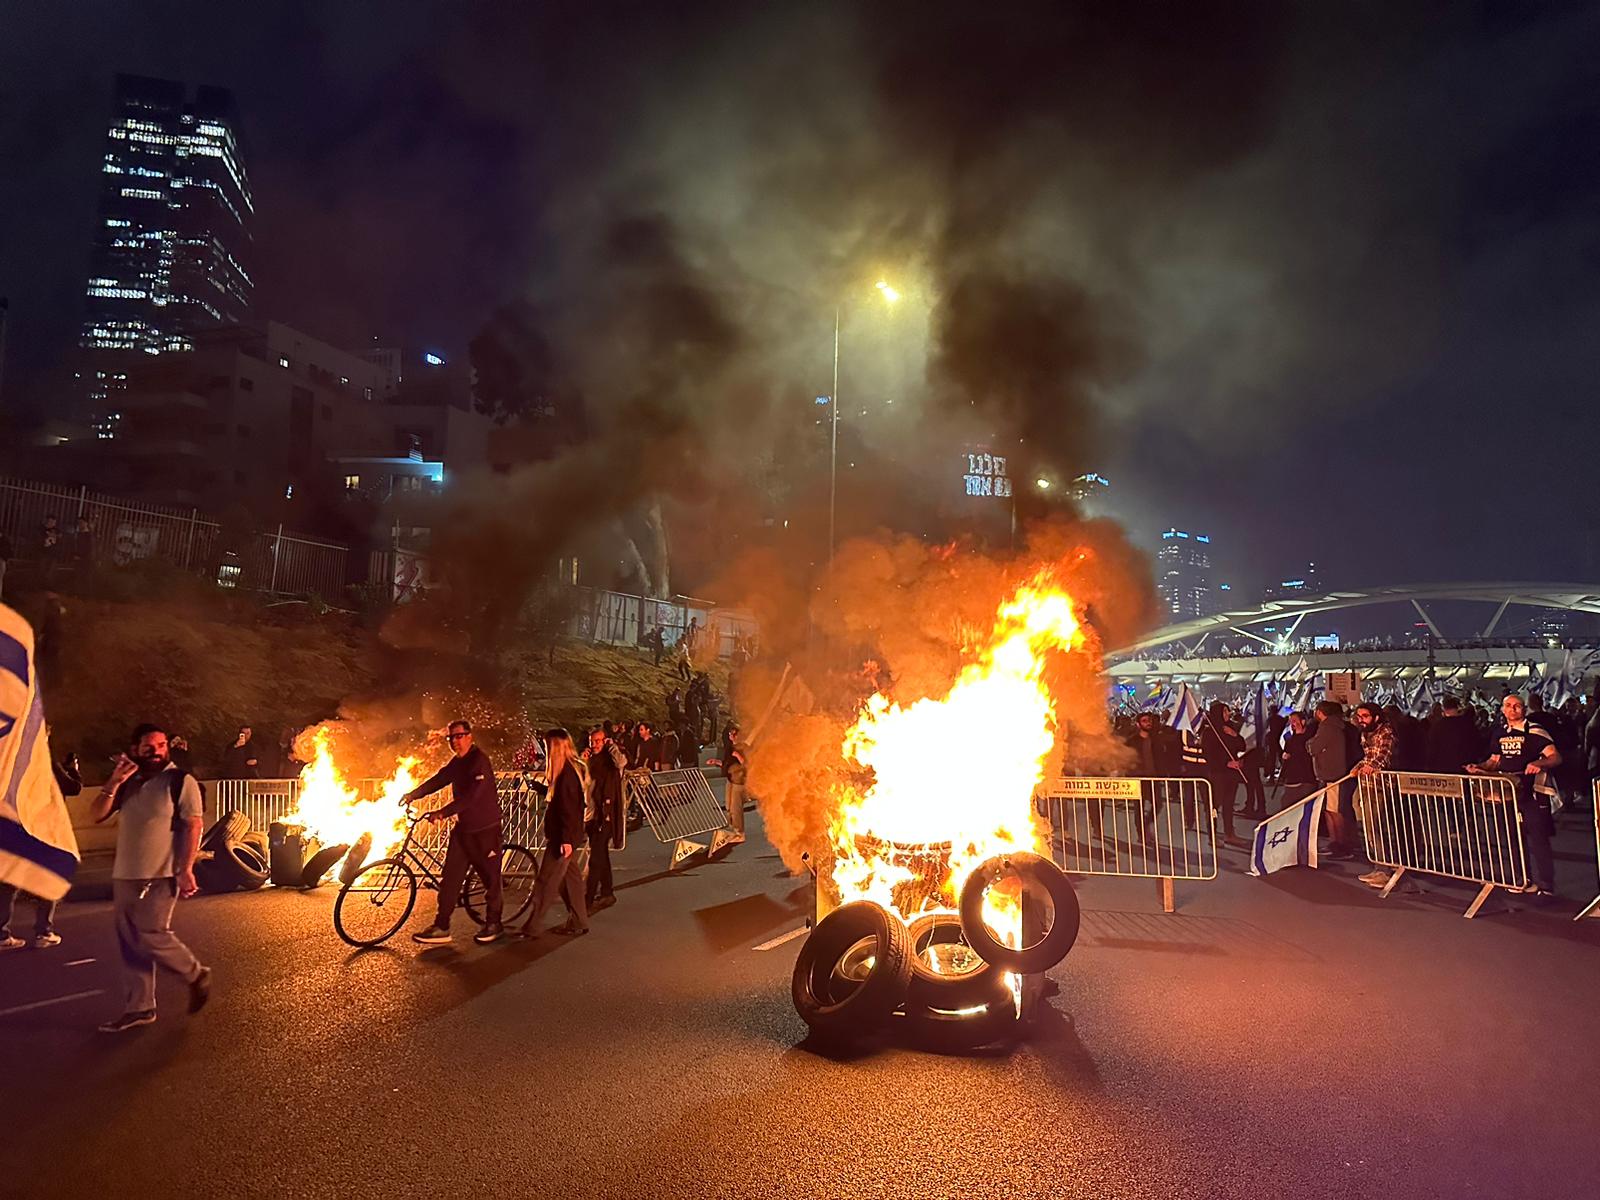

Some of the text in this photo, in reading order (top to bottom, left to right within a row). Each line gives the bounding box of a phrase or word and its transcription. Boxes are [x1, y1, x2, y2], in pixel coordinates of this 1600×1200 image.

[963, 475, 992, 496] אחד
[1501, 741, 1521, 750] גאה
[1065, 781, 1119, 790] קשת במות
